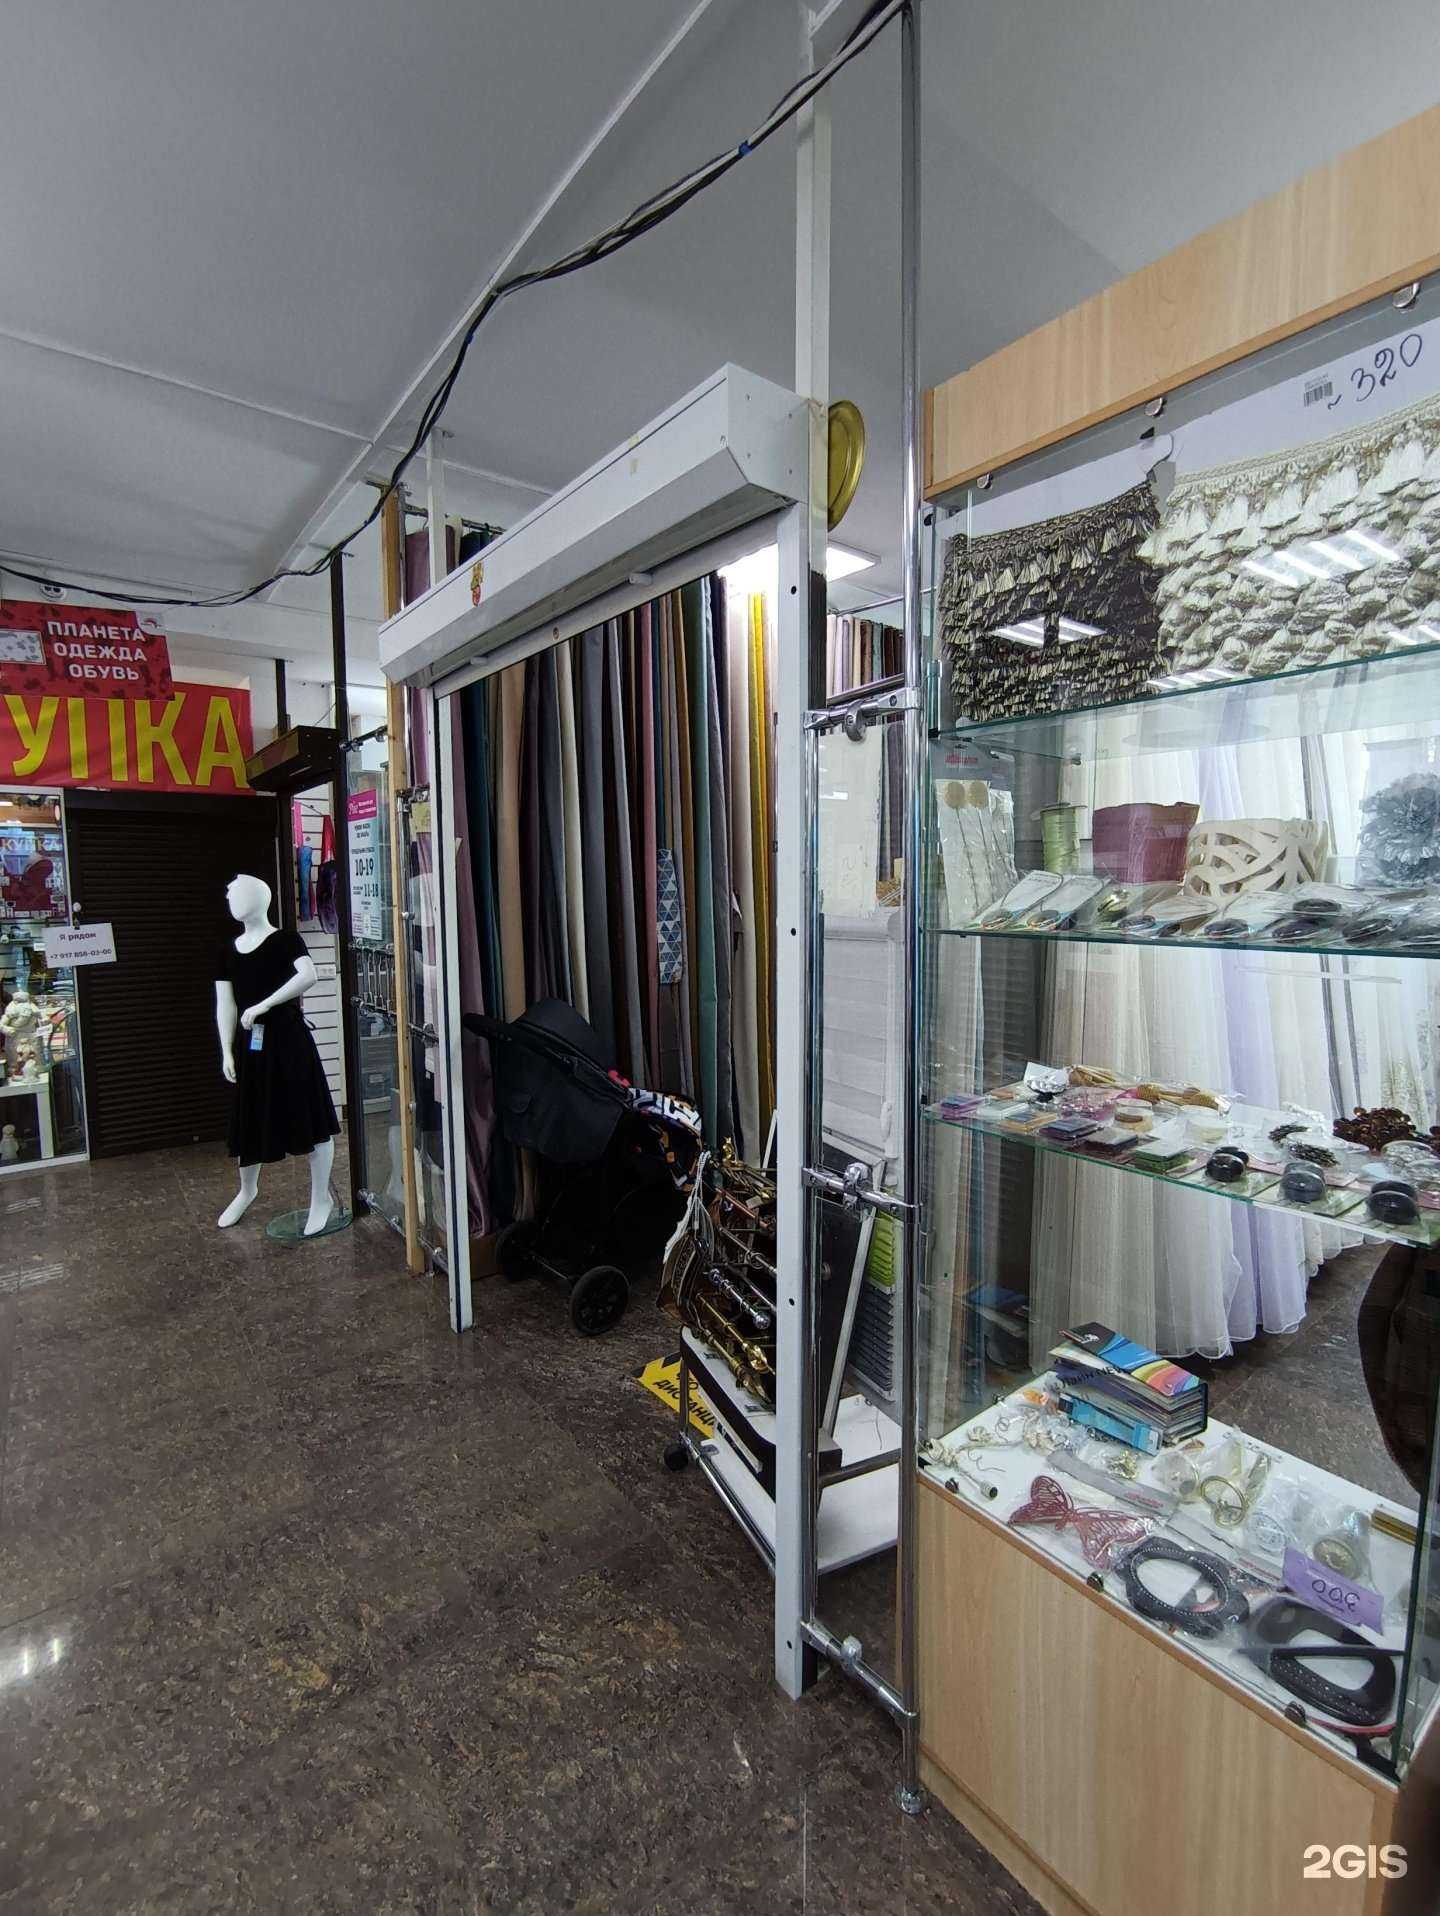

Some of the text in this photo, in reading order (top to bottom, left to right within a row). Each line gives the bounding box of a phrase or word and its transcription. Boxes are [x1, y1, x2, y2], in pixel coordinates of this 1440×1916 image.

[1350, 333, 1423, 402] 320
[47, 620, 147, 642] ПЛАНЕТА
[53, 642, 148, 662] ОДЕЖДА
[68, 663, 140, 681] ОБУВЬ
[355, 858, 374, 876] 10-19
[364, 883, 379, 897] 11-18
[68, 933, 97, 942] рядом
